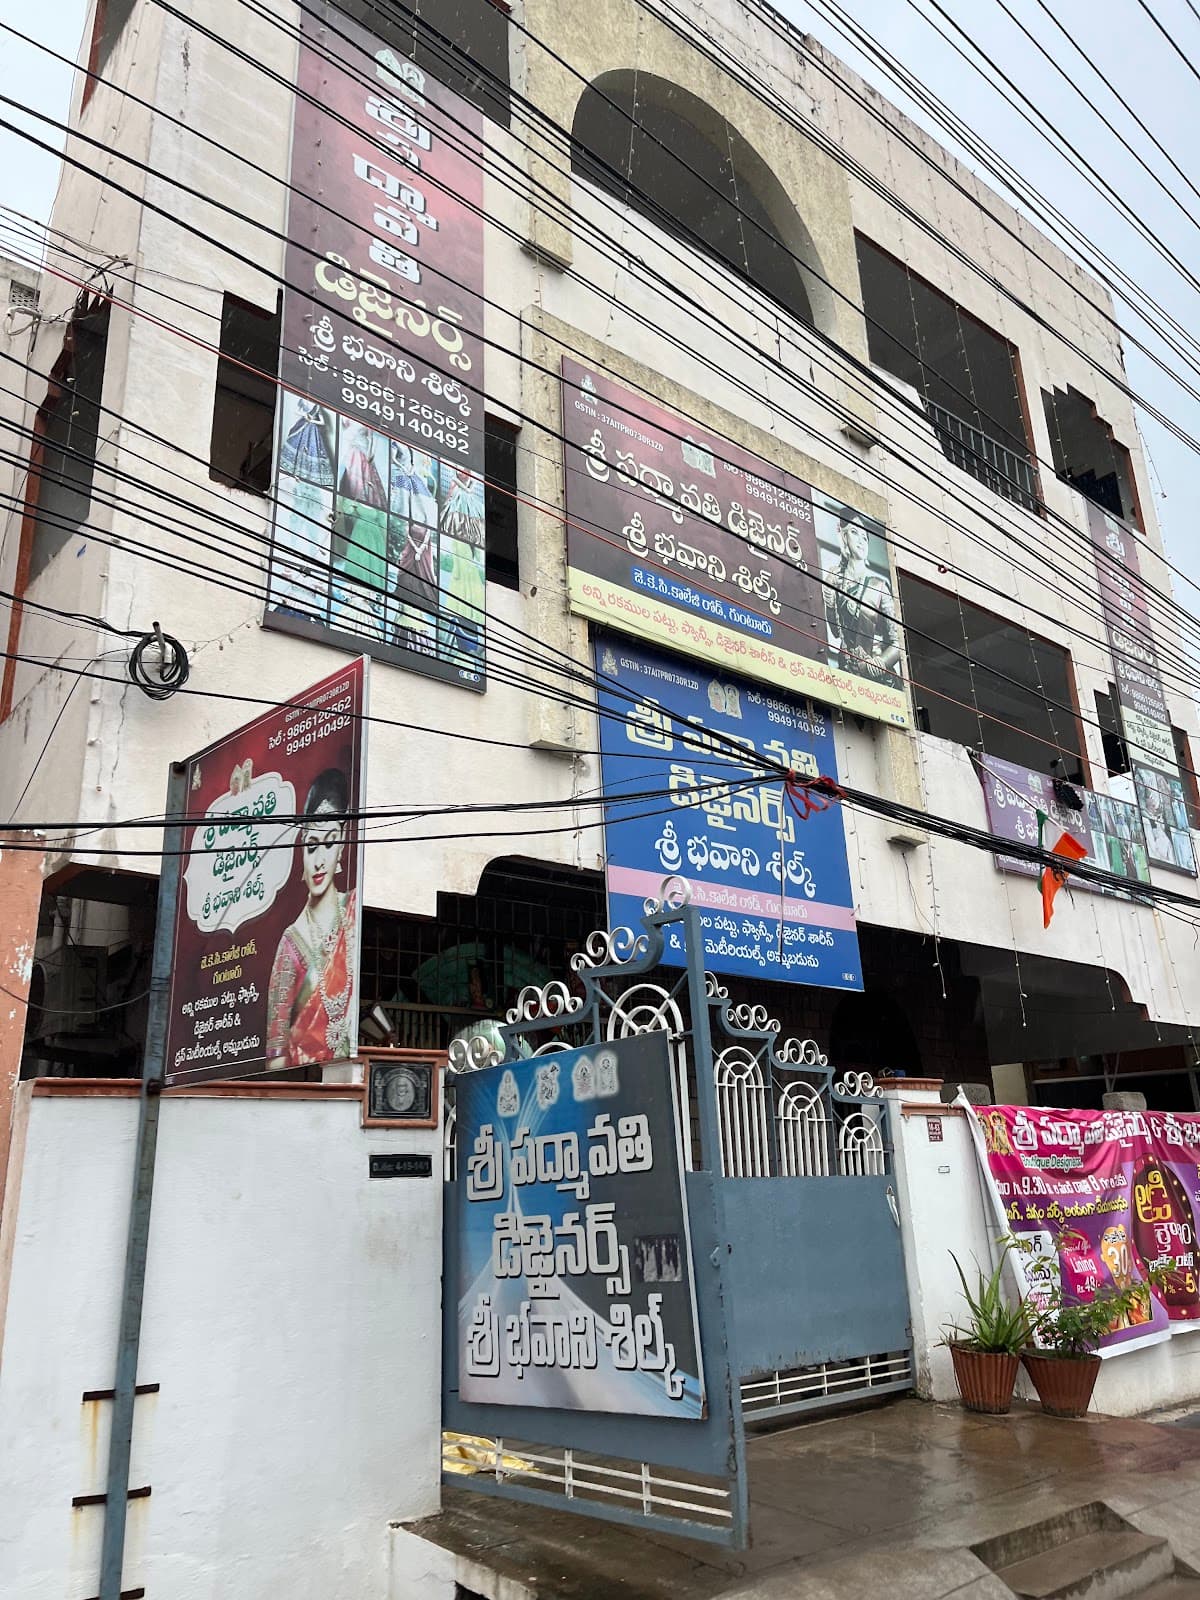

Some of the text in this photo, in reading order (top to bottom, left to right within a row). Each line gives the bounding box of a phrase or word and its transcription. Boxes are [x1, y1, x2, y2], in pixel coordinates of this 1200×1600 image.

[314, 251, 472, 371] డిజైనర్స్
[309, 315, 472, 417] శ్రీ భవాని శిల్క్
[341, 387, 470, 455] 9949140492
[574, 400, 597, 418] GSTIN
[580, 428, 808, 572] శ్రీ పద్మావతి డిజైనర్స్
[745, 484, 812, 523] 9949140492
[622, 510, 782, 615] శ్రీ భవాని శిల్క్
[729, 608, 772, 635] గుంటూరు
[620, 657, 640, 672] GSTIN
[626, 697, 674, 752] శ్రీ
[667, 763, 797, 844] డిజైనర్స్
[654, 819, 817, 899] శ్రీ భవాని శిల్క్
[201, 892, 211, 920] శ్రీ
[466, 1112, 654, 1202] శ్రీ పద్మావతి
[1012, 1110, 1039, 1151] శ్రీ
[1088, 1174, 1101, 1191] 8
[492, 1202, 631, 1301] డిజైనర్స్
[1069, 1256, 1098, 1275] Lining
[466, 1292, 687, 1399] శ్రీ భవాని శిల్క్
